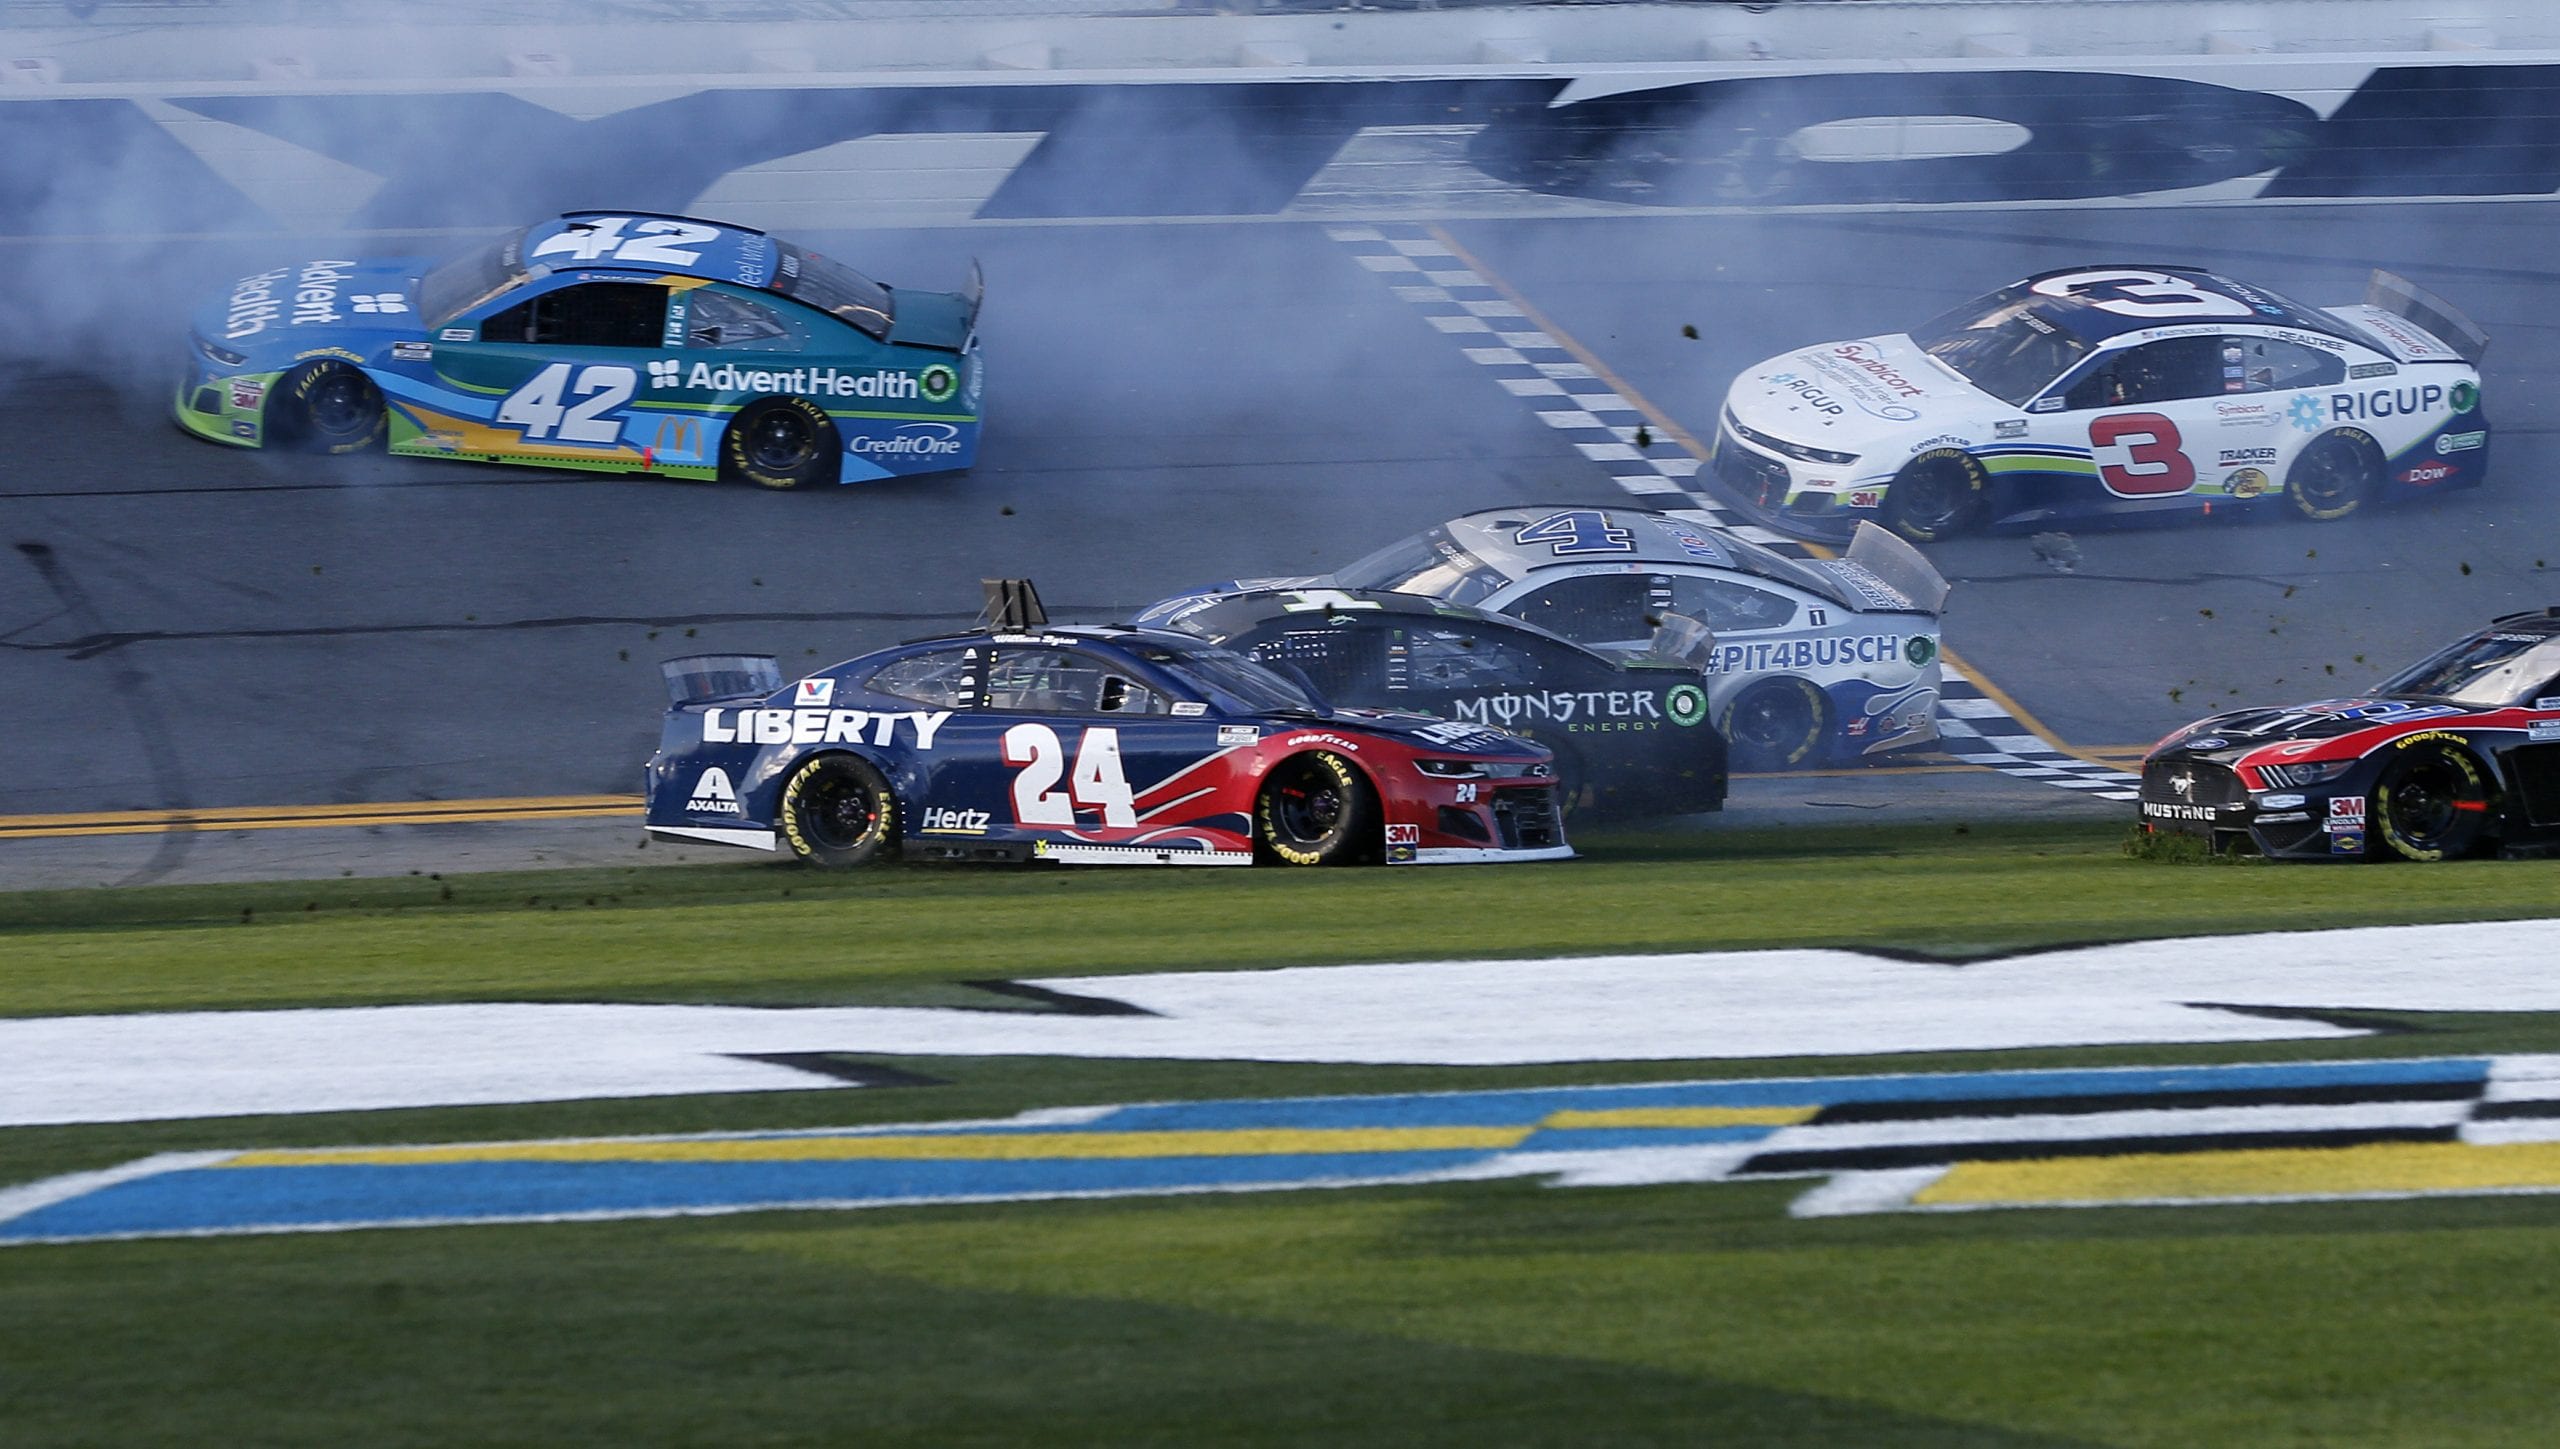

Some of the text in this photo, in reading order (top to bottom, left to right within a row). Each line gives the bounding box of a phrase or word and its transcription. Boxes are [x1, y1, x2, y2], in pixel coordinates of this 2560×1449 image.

[531, 218, 722, 267] 42
[226, 266, 290, 340] Health
[291, 260, 357, 325] Advent
[2030, 270, 2254, 318] 3
[2279, 330, 2345, 351] REALTREE
[295, 361, 331, 399] EAGLE
[686, 362, 917, 399] AdventHealth
[1834, 345, 1924, 398] Symbicort
[497, 363, 636, 443] 42
[791, 397, 829, 428] EAGLE
[1789, 379, 1844, 417] RIGUP
[2216, 404, 2265, 418] Symbicort
[2332, 384, 2442, 421] RIGUP
[1911, 434, 1971, 454] GOODYEAR
[2088, 411, 2197, 498] 3
[2219, 448, 2276, 461] TRACKER
[2335, 427, 2372, 446] EAGLE
[1917, 448, 1982, 491] GOODYEAR
[2409, 467, 2447, 482] DOW
[1851, 493, 1877, 506] 3M
[1513, 510, 1638, 557] 4
[1706, 635, 1898, 676] #PIT4BUSCH
[1454, 689, 1662, 724] MONSTER
[703, 708, 954, 750] LIBERTY
[1287, 733, 1359, 752] GOODYEAR
[1568, 721, 1661, 733] ENERGY
[2395, 730, 2468, 750] GOODYEAR
[1002, 722, 1138, 829] 24
[1316, 751, 1353, 787] EAGLE
[686, 799, 740, 814] AXALTA
[783, 758, 822, 856] GOODYEAR
[1455, 783, 1478, 803] 24
[2331, 799, 2364, 816] 3M
[873, 792, 892, 844] EAGLE
[921, 807, 991, 830] Hertz
[1259, 793, 1321, 865] GOODYEAR
[2143, 802, 2217, 821] MUSTANG
[1387, 826, 1418, 843] 3M
